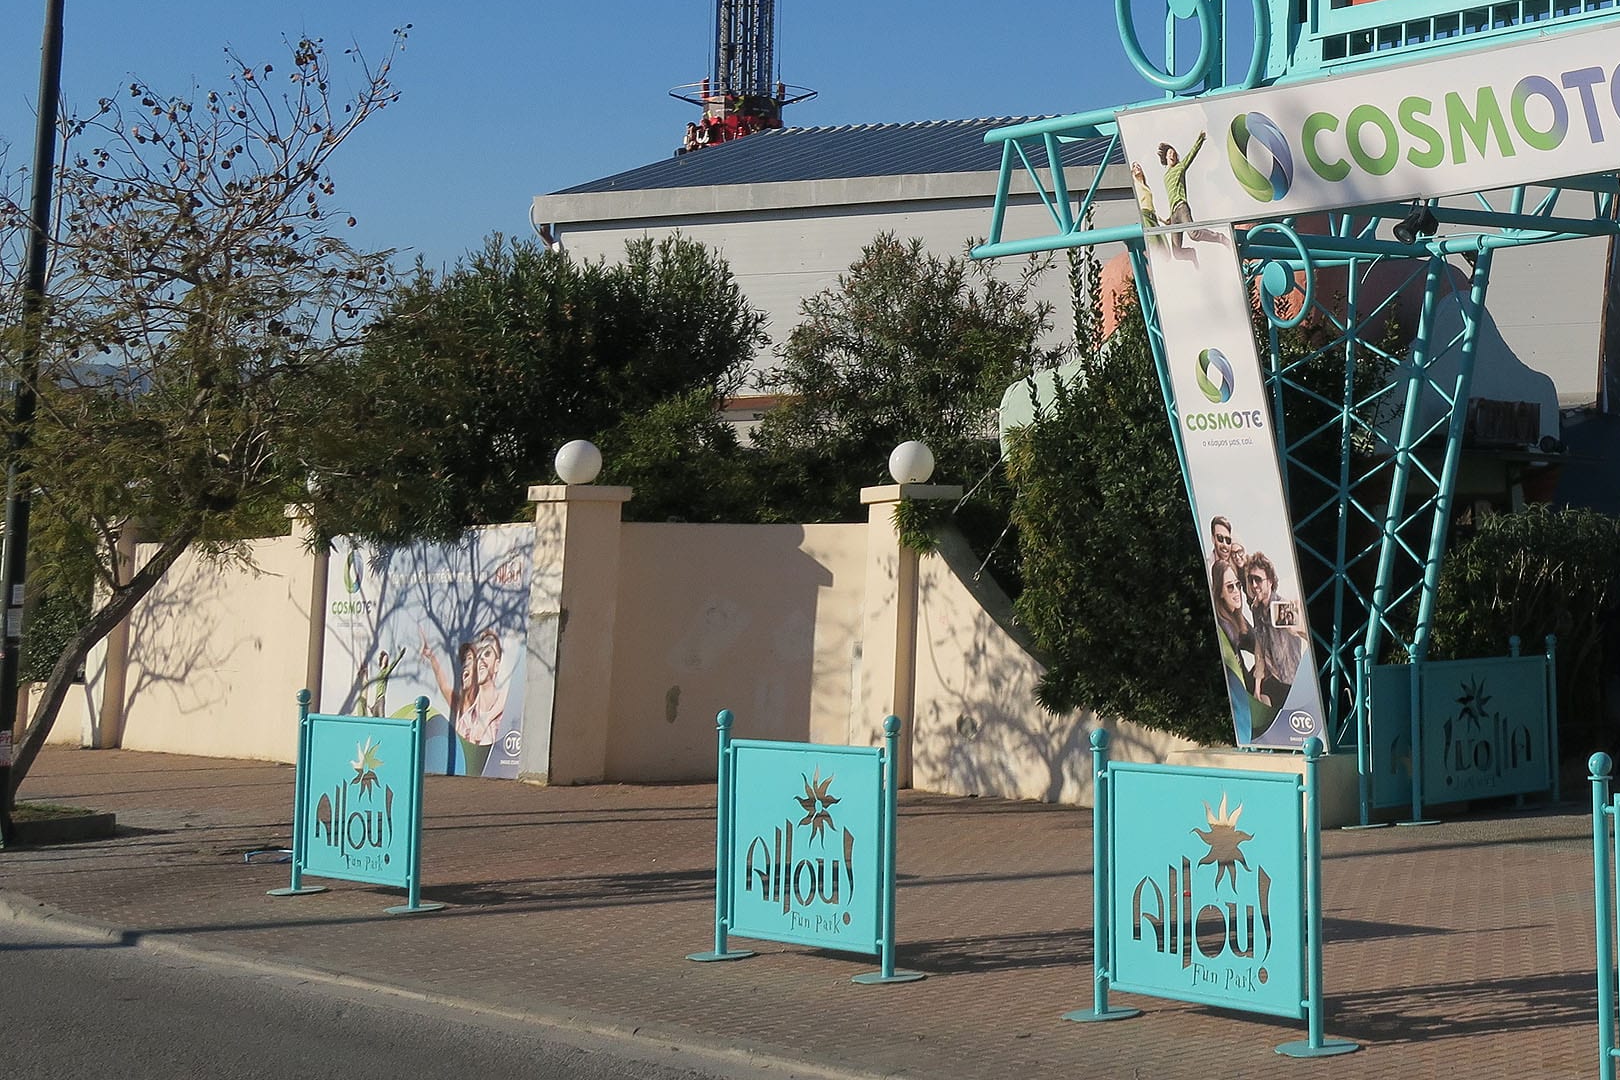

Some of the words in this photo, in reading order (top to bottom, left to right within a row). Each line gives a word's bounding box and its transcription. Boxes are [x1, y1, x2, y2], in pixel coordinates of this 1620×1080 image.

[1185, 410, 1263, 431] COSMOTE
[332, 600, 373, 615] COSMOTE
[1291, 716, 1313, 729] OTE
[315, 779, 394, 865] Allou!
[745, 818, 855, 925] Allou!
[791, 911, 810, 931] Fun
[816, 912, 841, 934] Park
[1132, 855, 1272, 985] Allou!
[1191, 962, 1218, 987] Fun
[1225, 967, 1257, 993] Park
